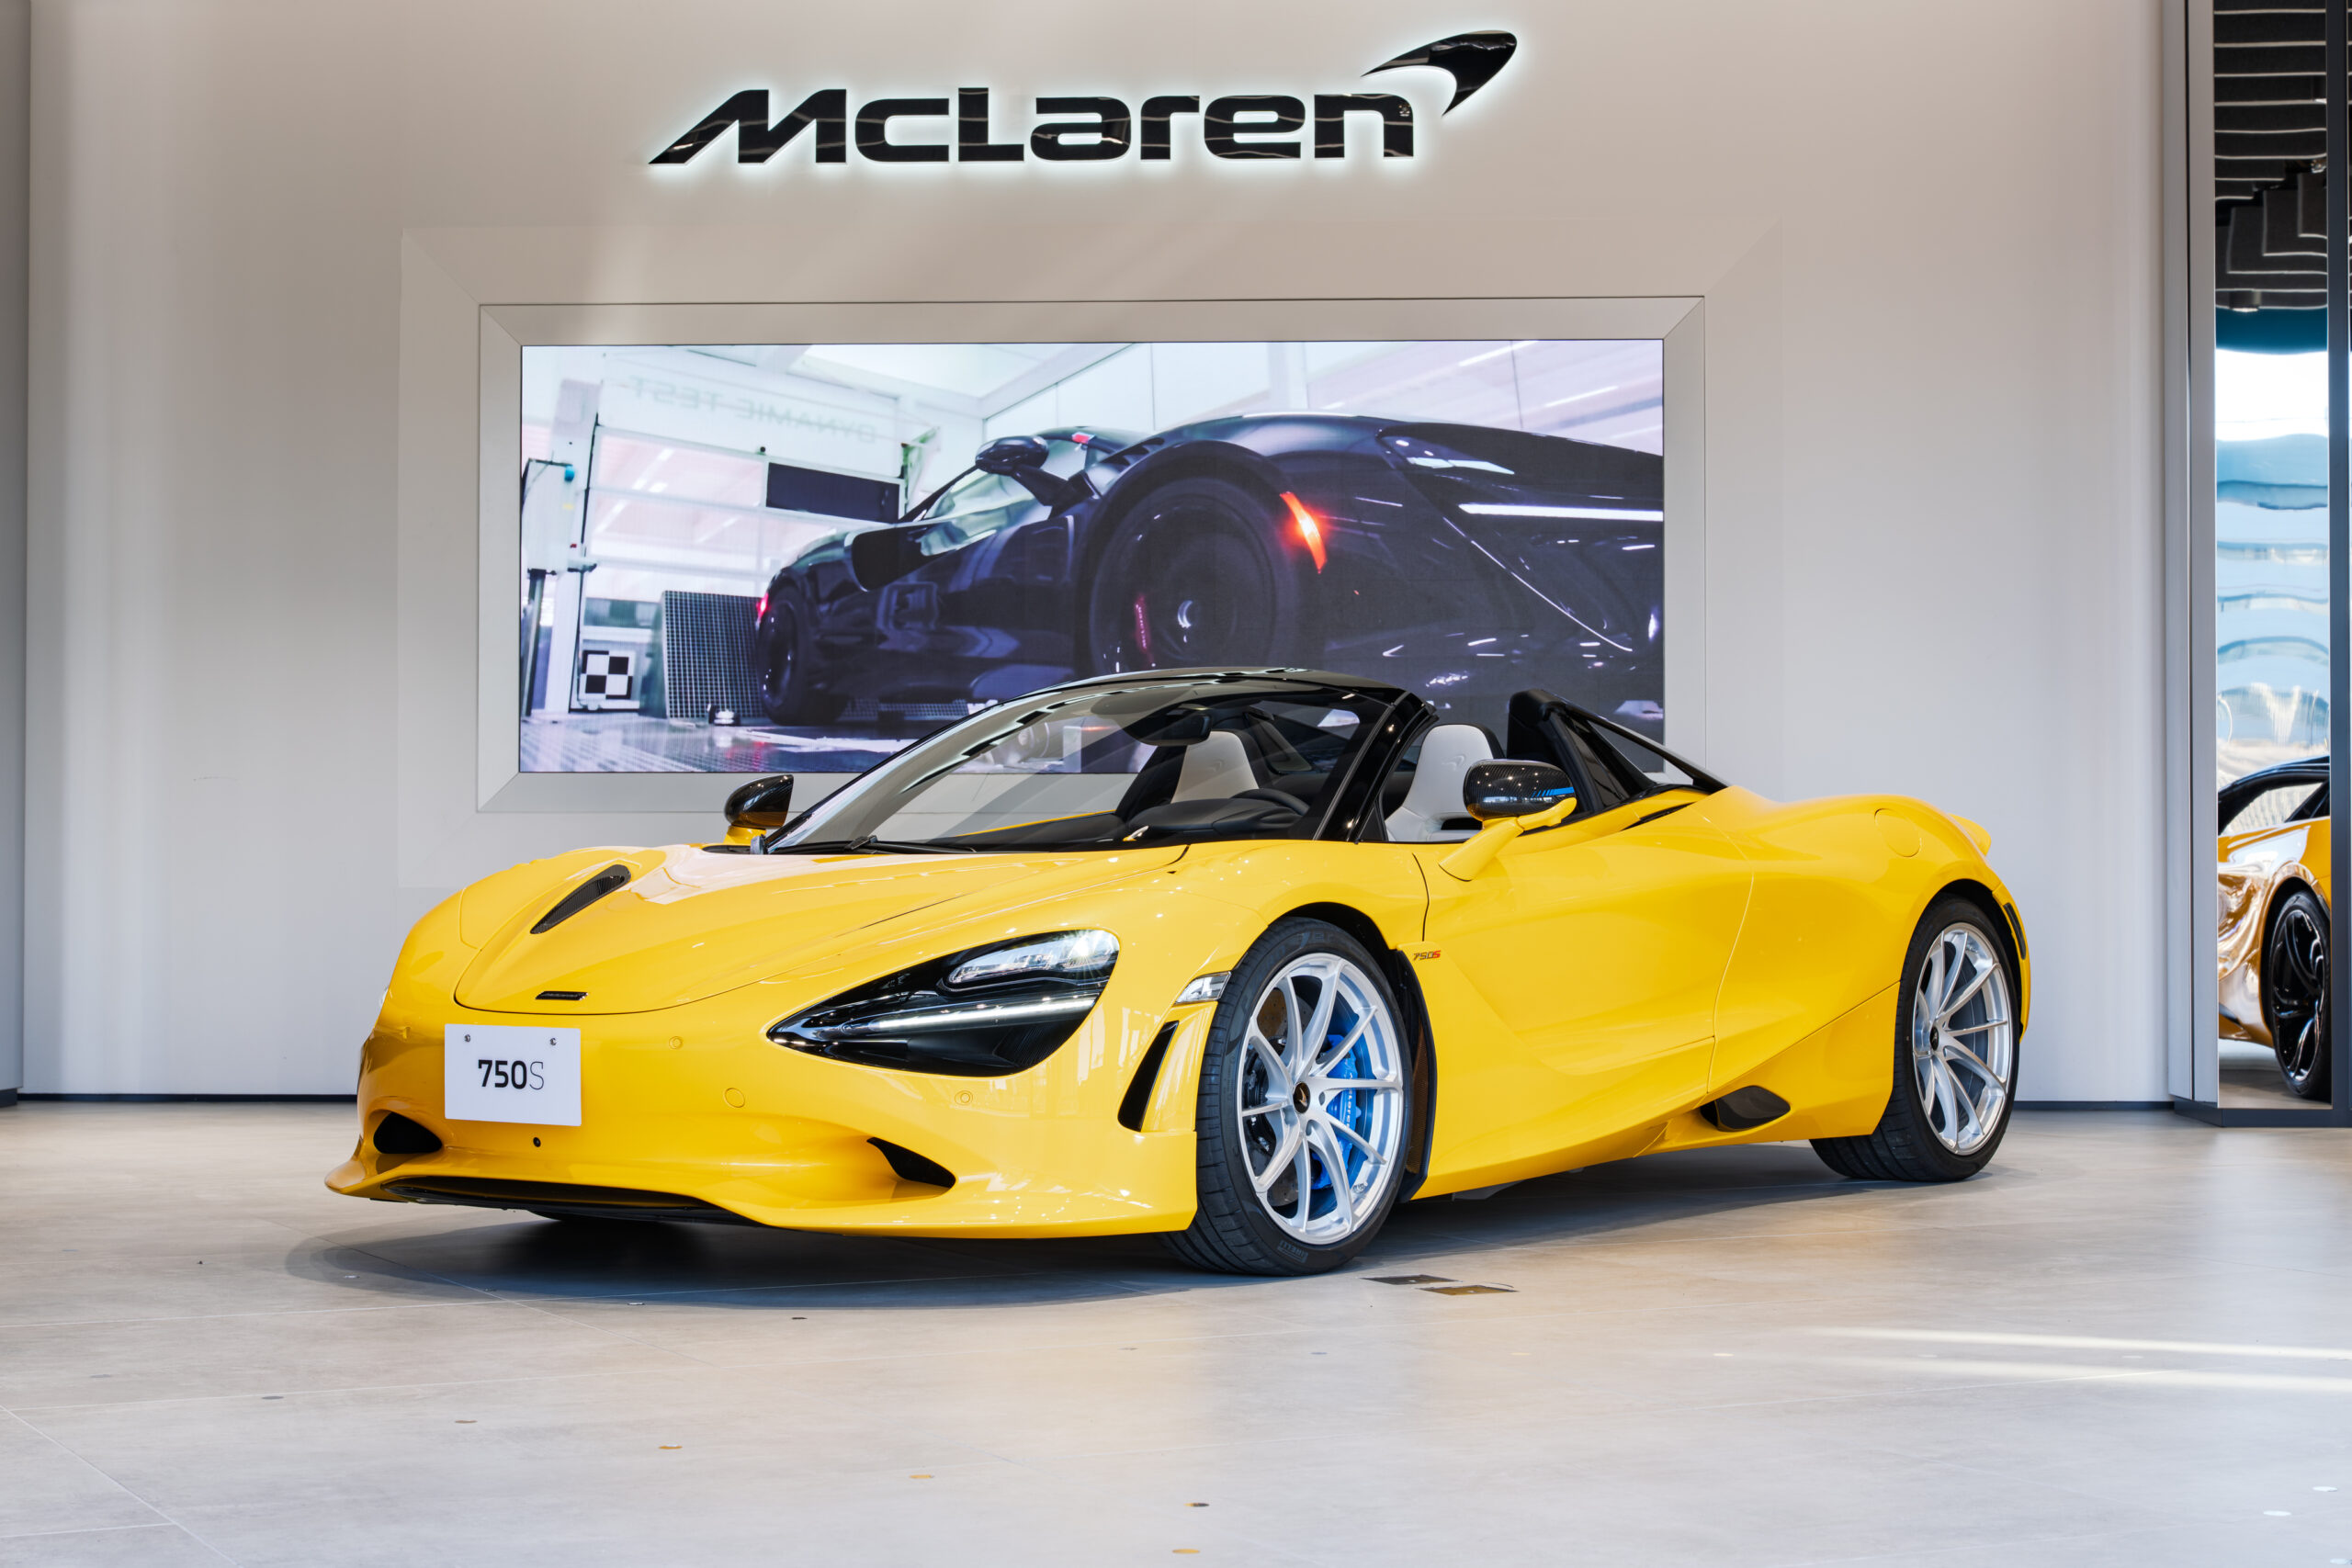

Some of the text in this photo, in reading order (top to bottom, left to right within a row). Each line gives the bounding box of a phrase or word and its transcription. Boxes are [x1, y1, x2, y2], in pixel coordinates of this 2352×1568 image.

[649, 88, 1415, 165] McLaren
[1413, 950, 1442, 961] 750S
[478, 1059, 545, 1090] 750S
